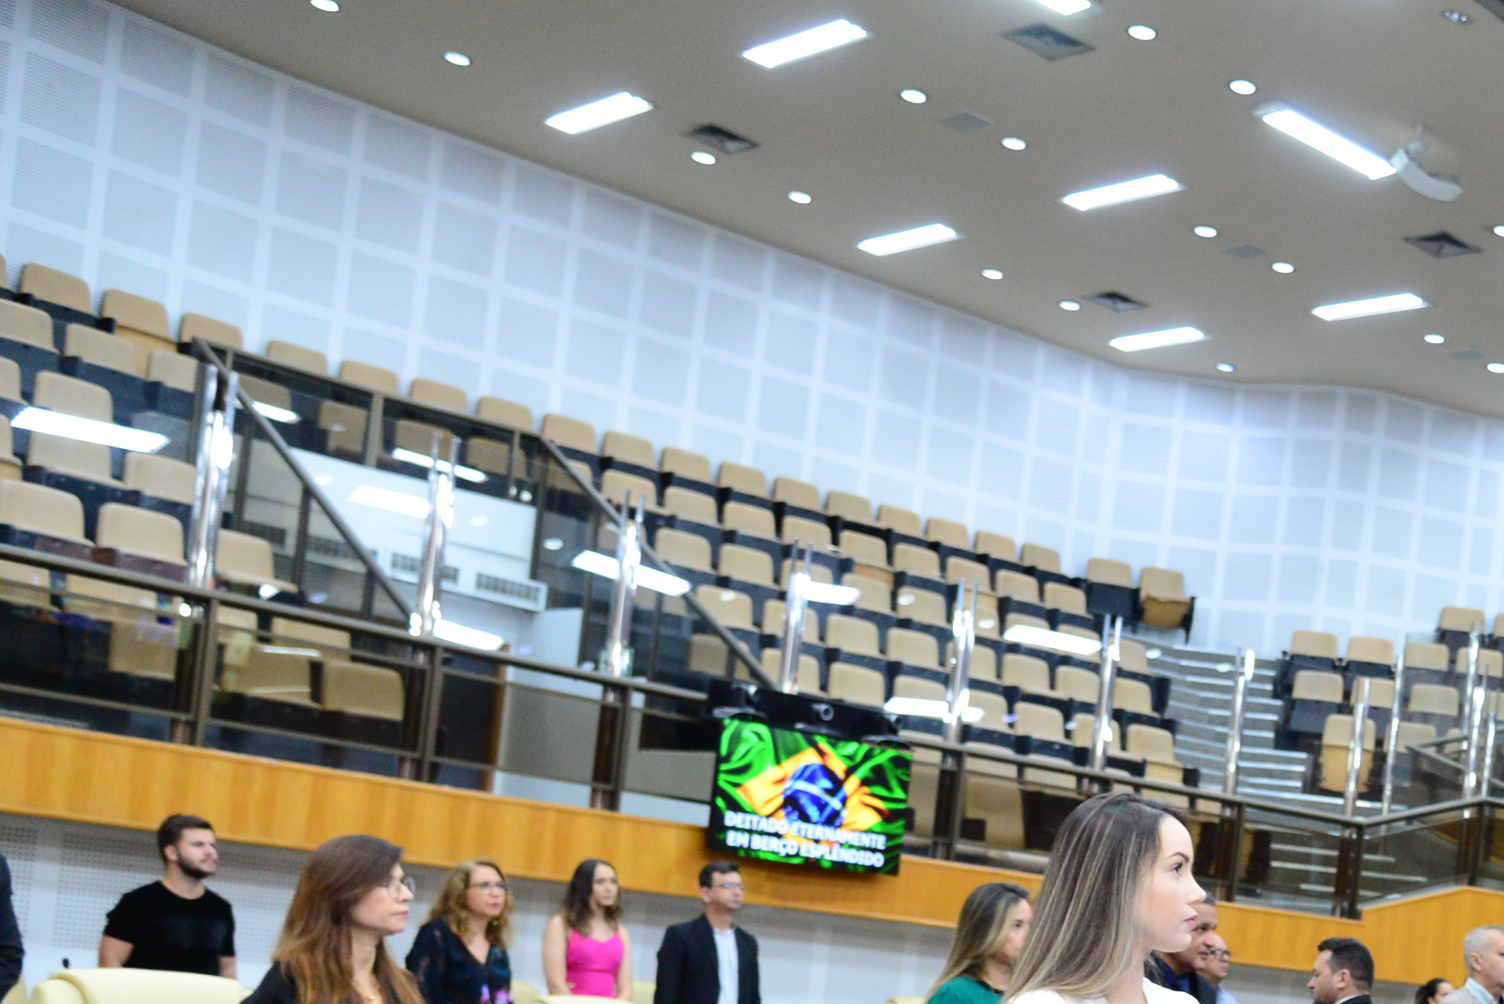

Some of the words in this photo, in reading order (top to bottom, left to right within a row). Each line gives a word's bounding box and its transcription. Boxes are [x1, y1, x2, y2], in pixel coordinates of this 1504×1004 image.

[724, 811, 789, 834] DEITADO
[792, 821, 887, 850] ETERNAMENTE
[726, 830, 749, 848] EM
[750, 834, 798, 857] BERÇO
[800, 842, 885, 868] ESPLÊNDIDO
